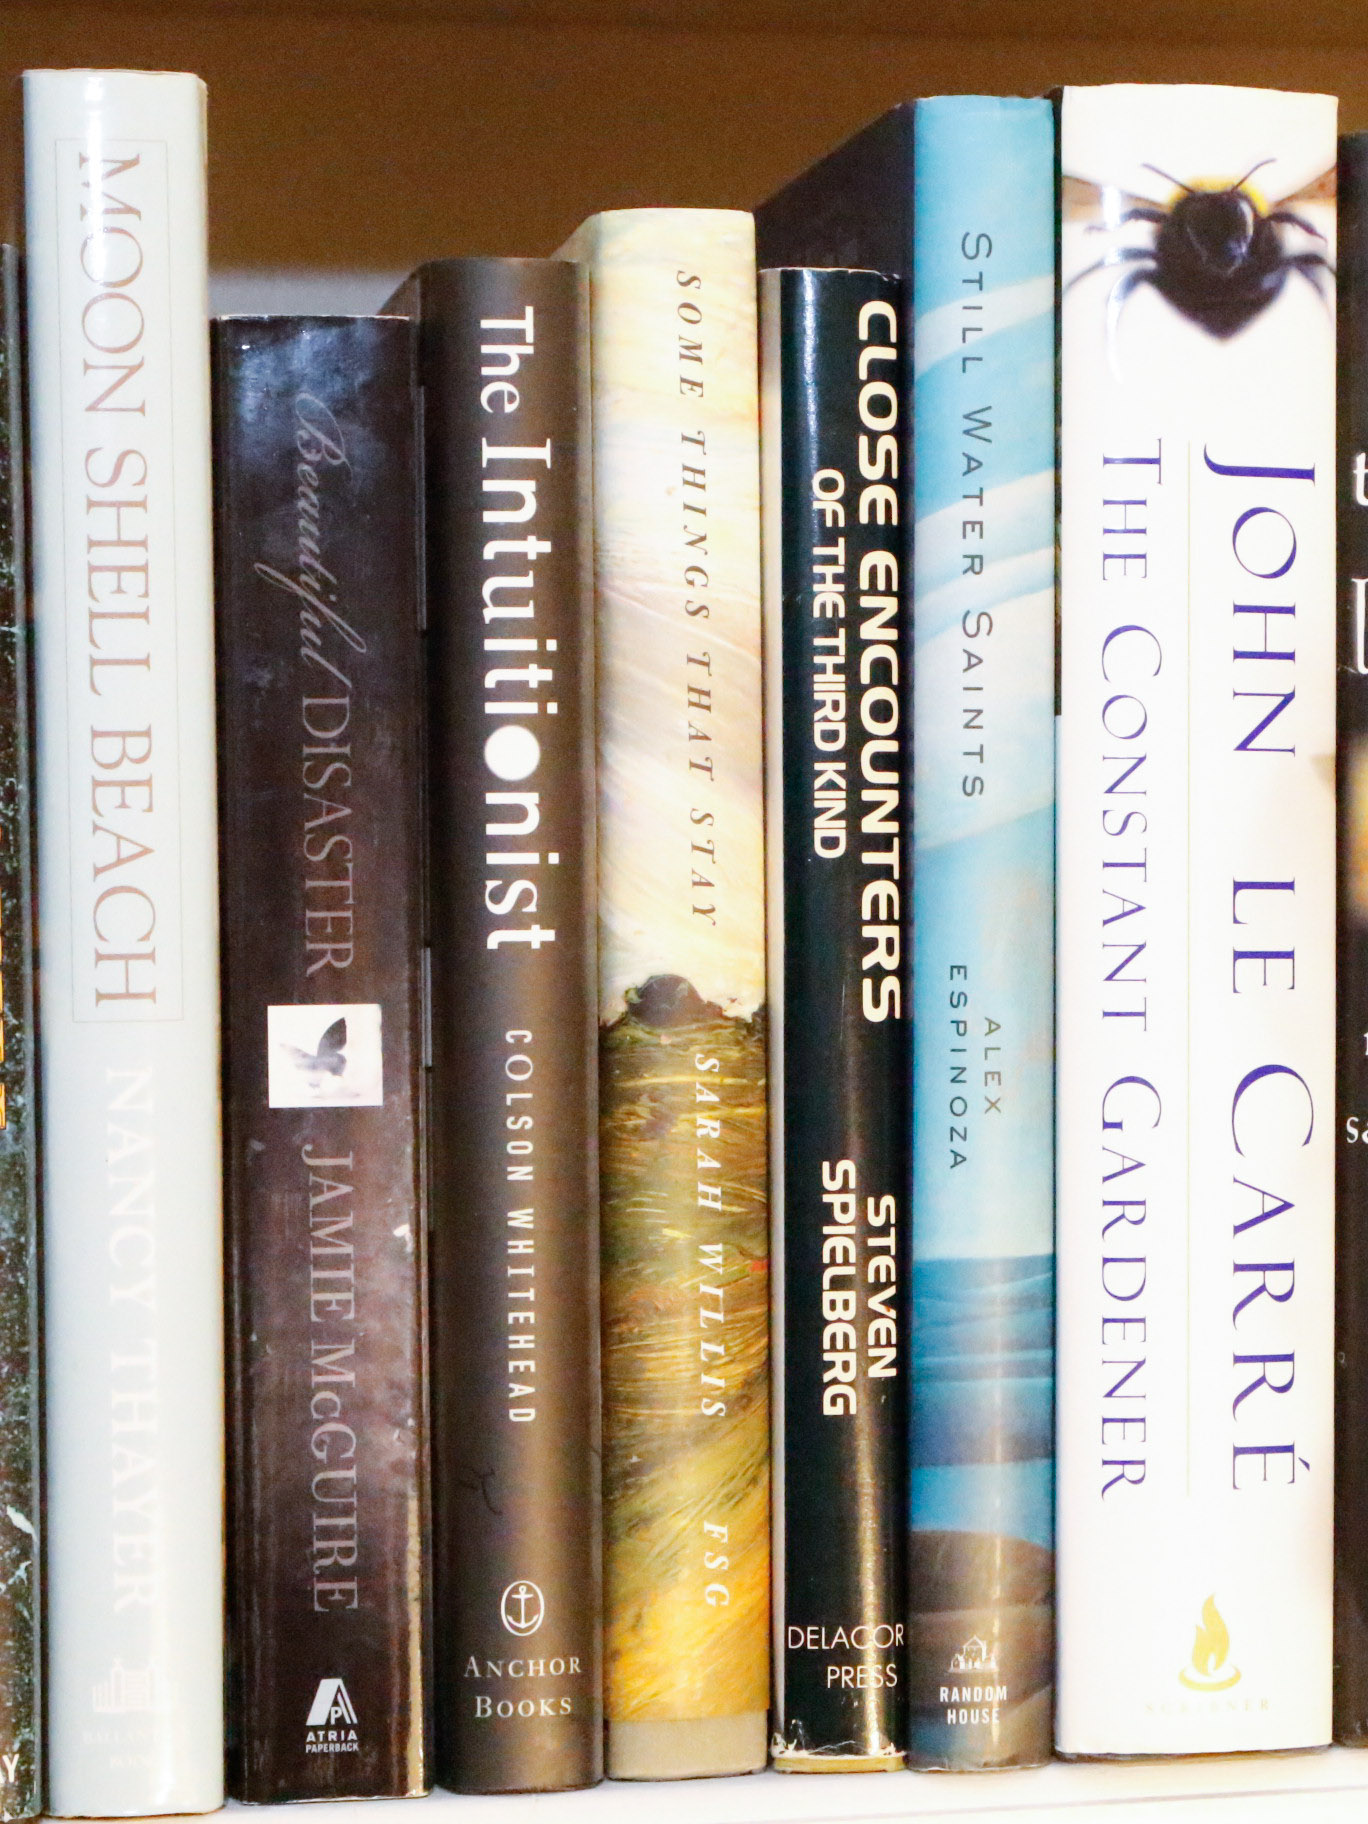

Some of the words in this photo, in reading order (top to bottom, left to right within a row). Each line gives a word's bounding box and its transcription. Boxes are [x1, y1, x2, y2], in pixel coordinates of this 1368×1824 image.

[78, 152, 145, 417] MOON
[480, 306, 535, 413] The
[676, 270, 704, 398] SOME
[961, 232, 993, 374] STILL
[858, 300, 899, 526] CLOSE
[961, 405, 993, 577] WATER
[83, 448, 152, 696] SHELL
[256, 391, 368, 688] Beautiful
[680, 430, 710, 619] THINGS
[812, 468, 846, 532] OF
[813, 545, 846, 619] THE
[1103, 437, 1163, 582] THE
[1204, 443, 1317, 758] JOHN
[686, 652, 715, 783] THAT
[813, 628, 847, 754] THIRD
[961, 611, 993, 798] SAINTS
[90, 727, 157, 1007] BEACH
[300, 693, 355, 977] DISASTER
[690, 807, 717, 926] STAY
[814, 762, 847, 860] KIND
[857, 550, 902, 1023] ENCOUNTERS
[1101, 624, 1163, 1032] CONSTANT
[1232, 876, 1297, 994] LE
[505, 1029, 535, 1182] COLSON
[695, 1053, 723, 1212] SARAH
[949, 964, 968, 1171] ESPINOZA
[983, 1017, 1003, 1116] ALEX
[107, 1066, 156, 1303] NANCY
[301, 1143, 355, 1323] JAMIE
[507, 1207, 538, 1425] WHITEHEAD
[699, 1243, 727, 1418] WILLIS
[821, 1159, 857, 1417] SPIELBERG
[866, 1194, 897, 1379] STEVEN
[1101, 1074, 1163, 1502] GARDENER
[1231, 1063, 1315, 1492] CARRÉ
[110, 1337, 157, 1614] THAYER
[703, 1519, 730, 1607] FSG
[305, 1743, 359, 1753] PAPERBACK
[306, 1730, 357, 1743] ATRIA
[464, 1656, 582, 1678] ANCHOR
[474, 1696, 572, 1718] BOOKS
[827, 1664, 898, 1689] PRESS
[939, 1686, 1008, 1703] RANDOM
[947, 1709, 1000, 1725] HOUSE
